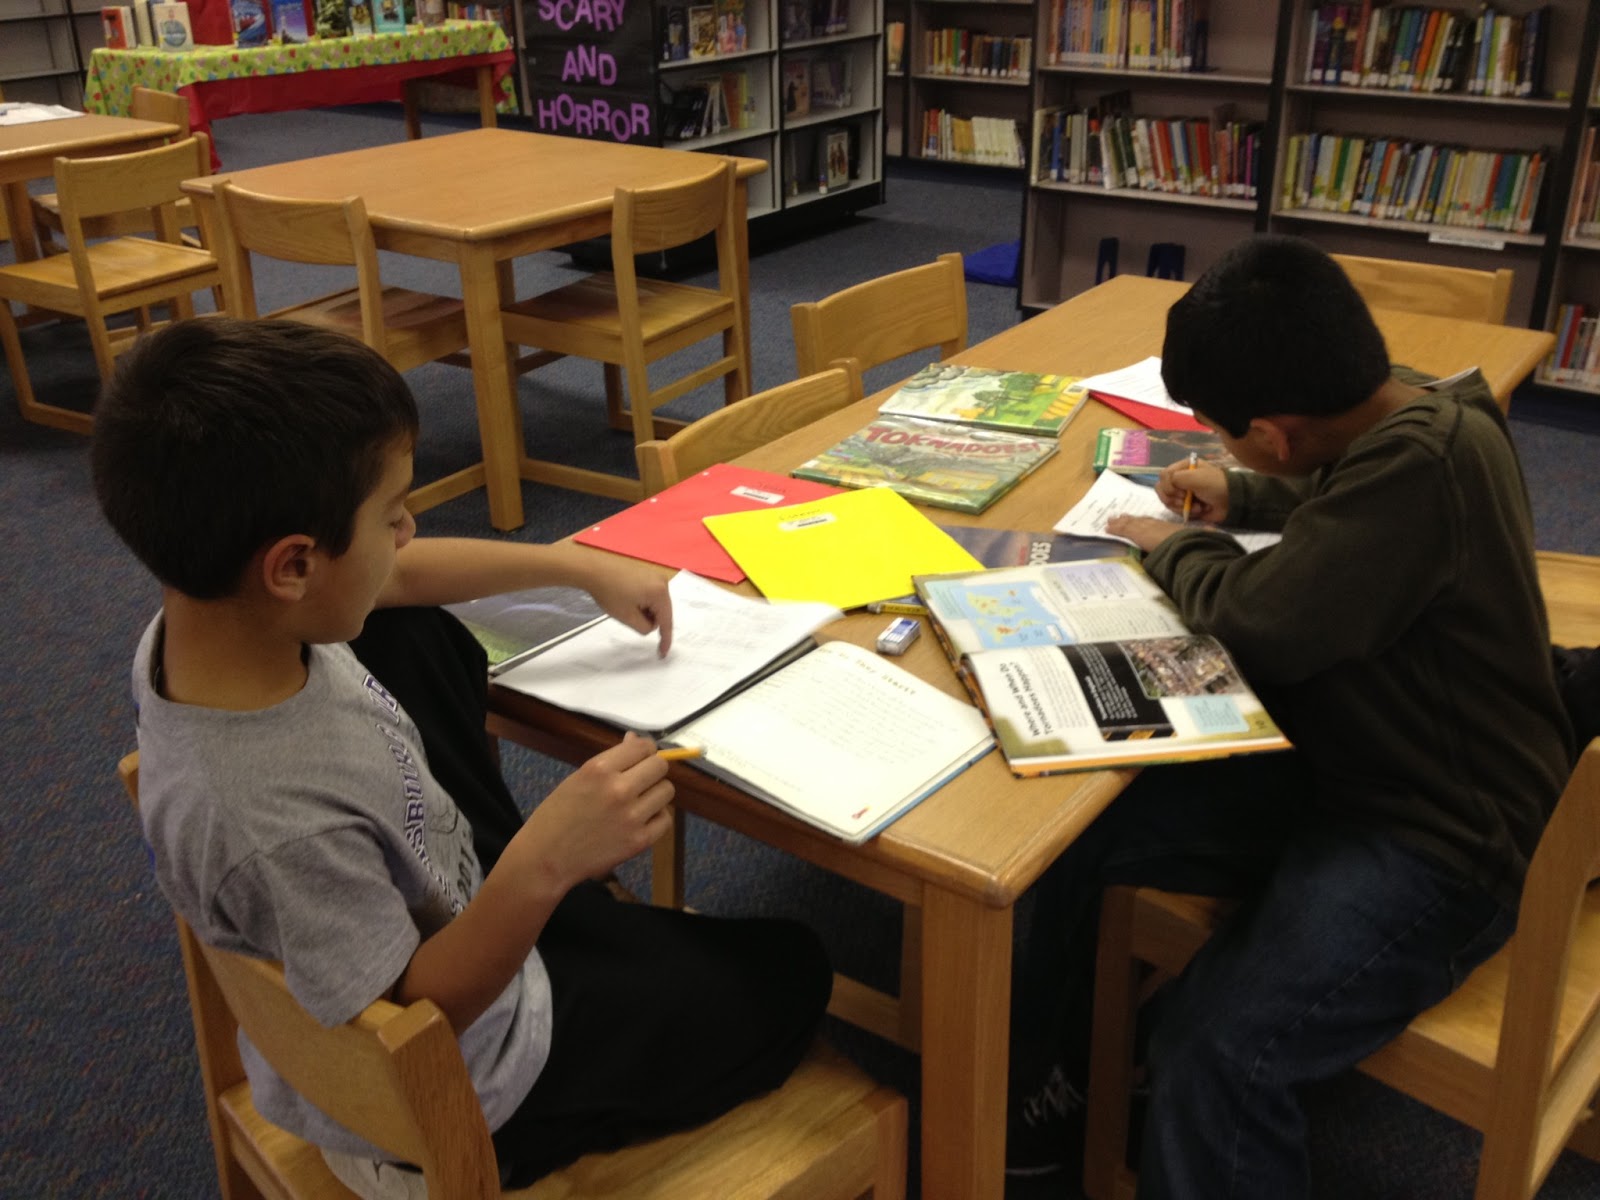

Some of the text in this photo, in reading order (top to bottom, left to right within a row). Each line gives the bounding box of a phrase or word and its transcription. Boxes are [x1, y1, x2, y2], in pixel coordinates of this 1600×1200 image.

[538, 0, 625, 31] SCARY
[561, 44, 617, 86] AND
[537, 93, 651, 142] HORROR
